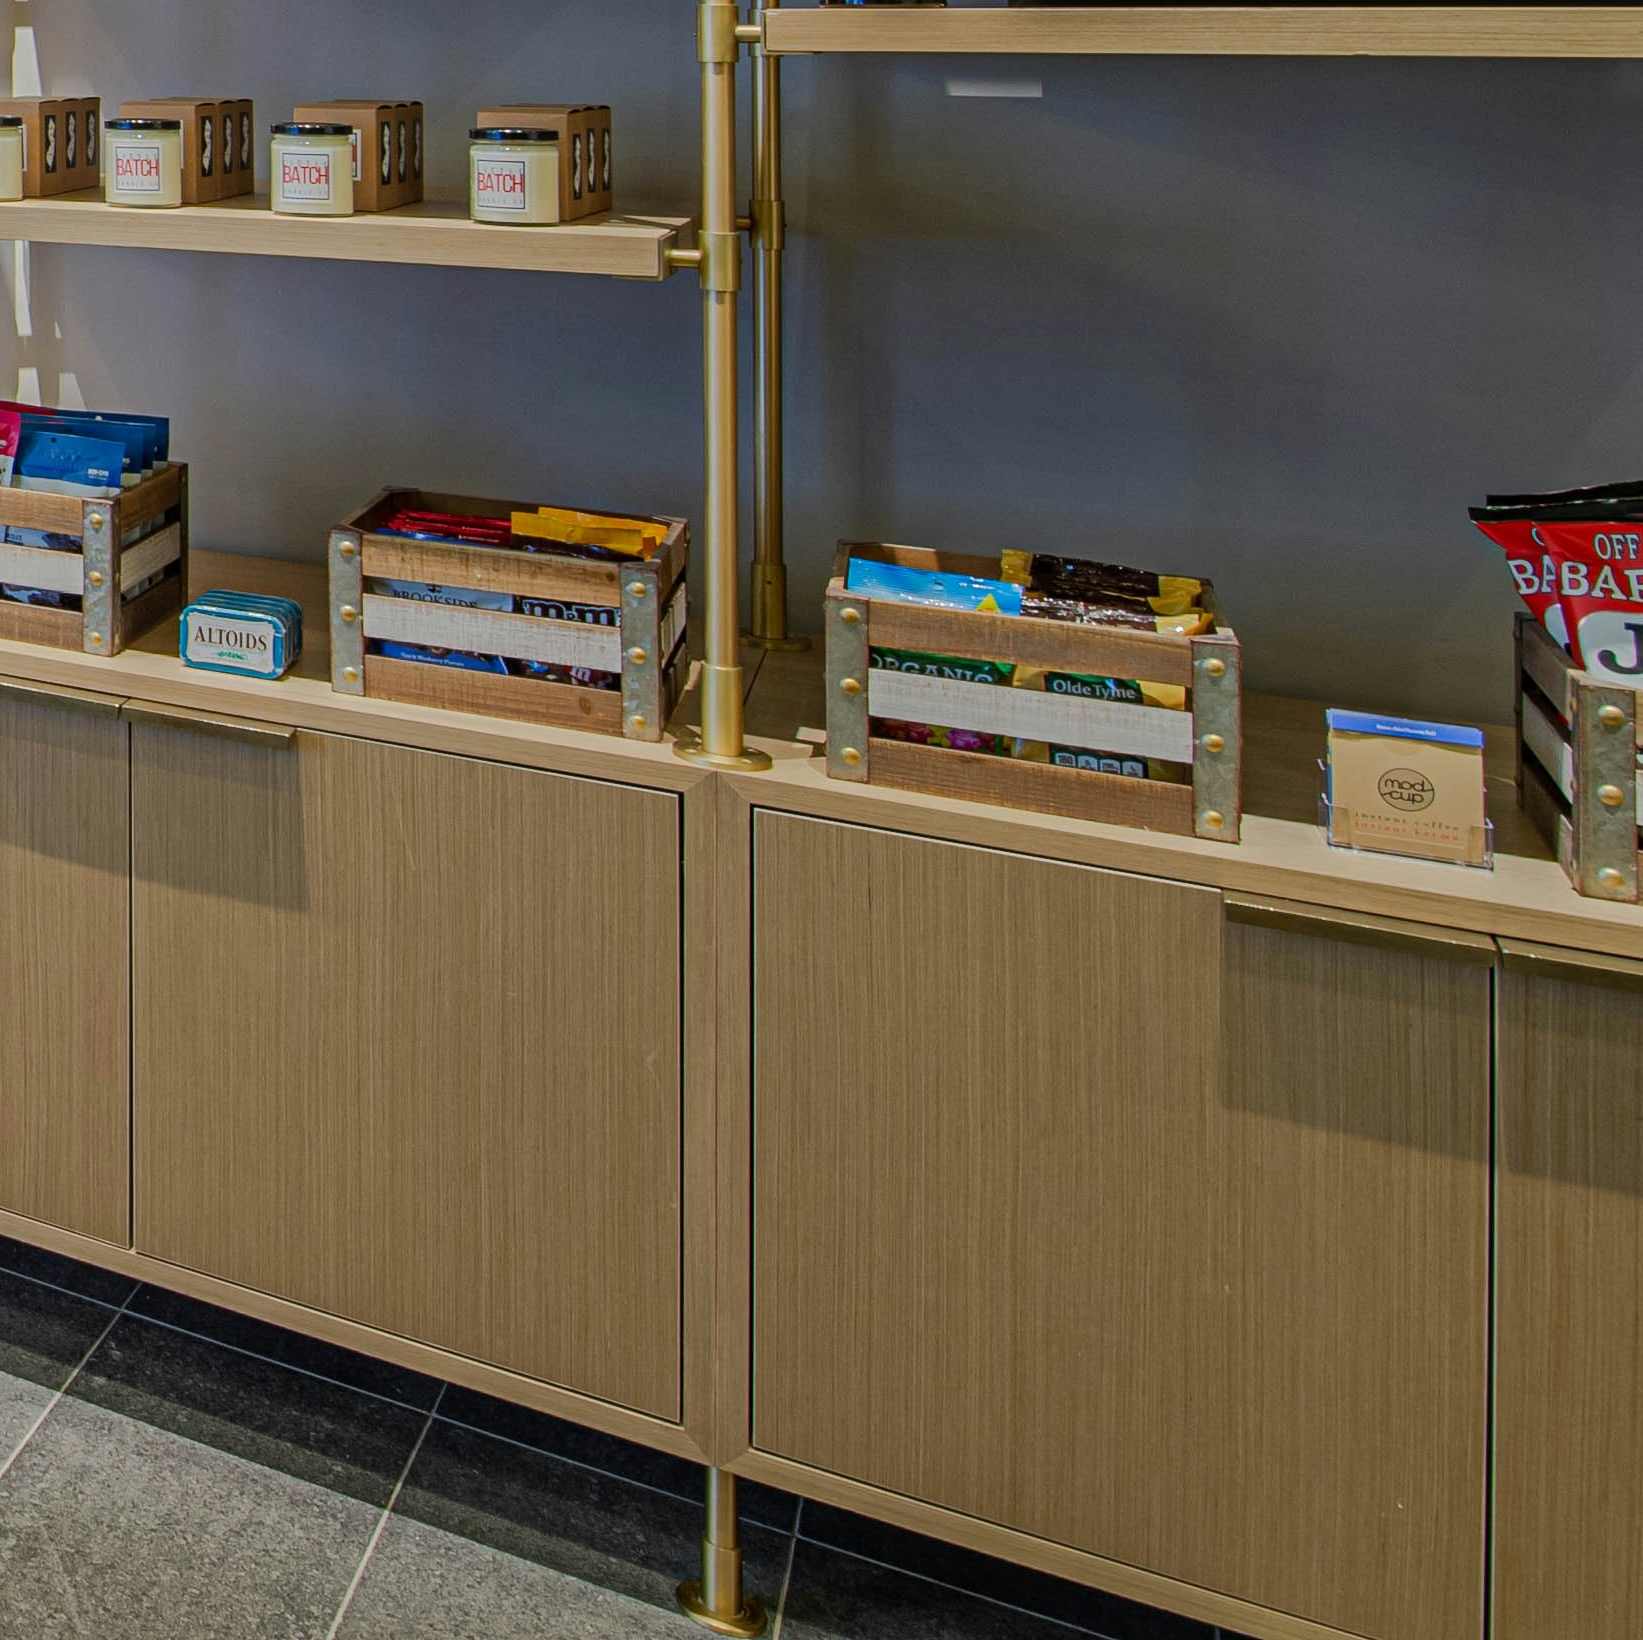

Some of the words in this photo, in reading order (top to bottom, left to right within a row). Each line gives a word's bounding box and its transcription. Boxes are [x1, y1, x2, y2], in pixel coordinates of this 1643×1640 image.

[116, 158, 159, 177] BATCH
[282, 164, 330, 185] BATCH
[477, 171, 524, 193] BATCH
[195, 625, 268, 652] ALTOIDS
[1053, 679, 1092, 696] Olde
[1092, 682, 1137, 700] Tyme
[1384, 778, 1434, 793] mod
[1382, 790, 1425, 805] cup
